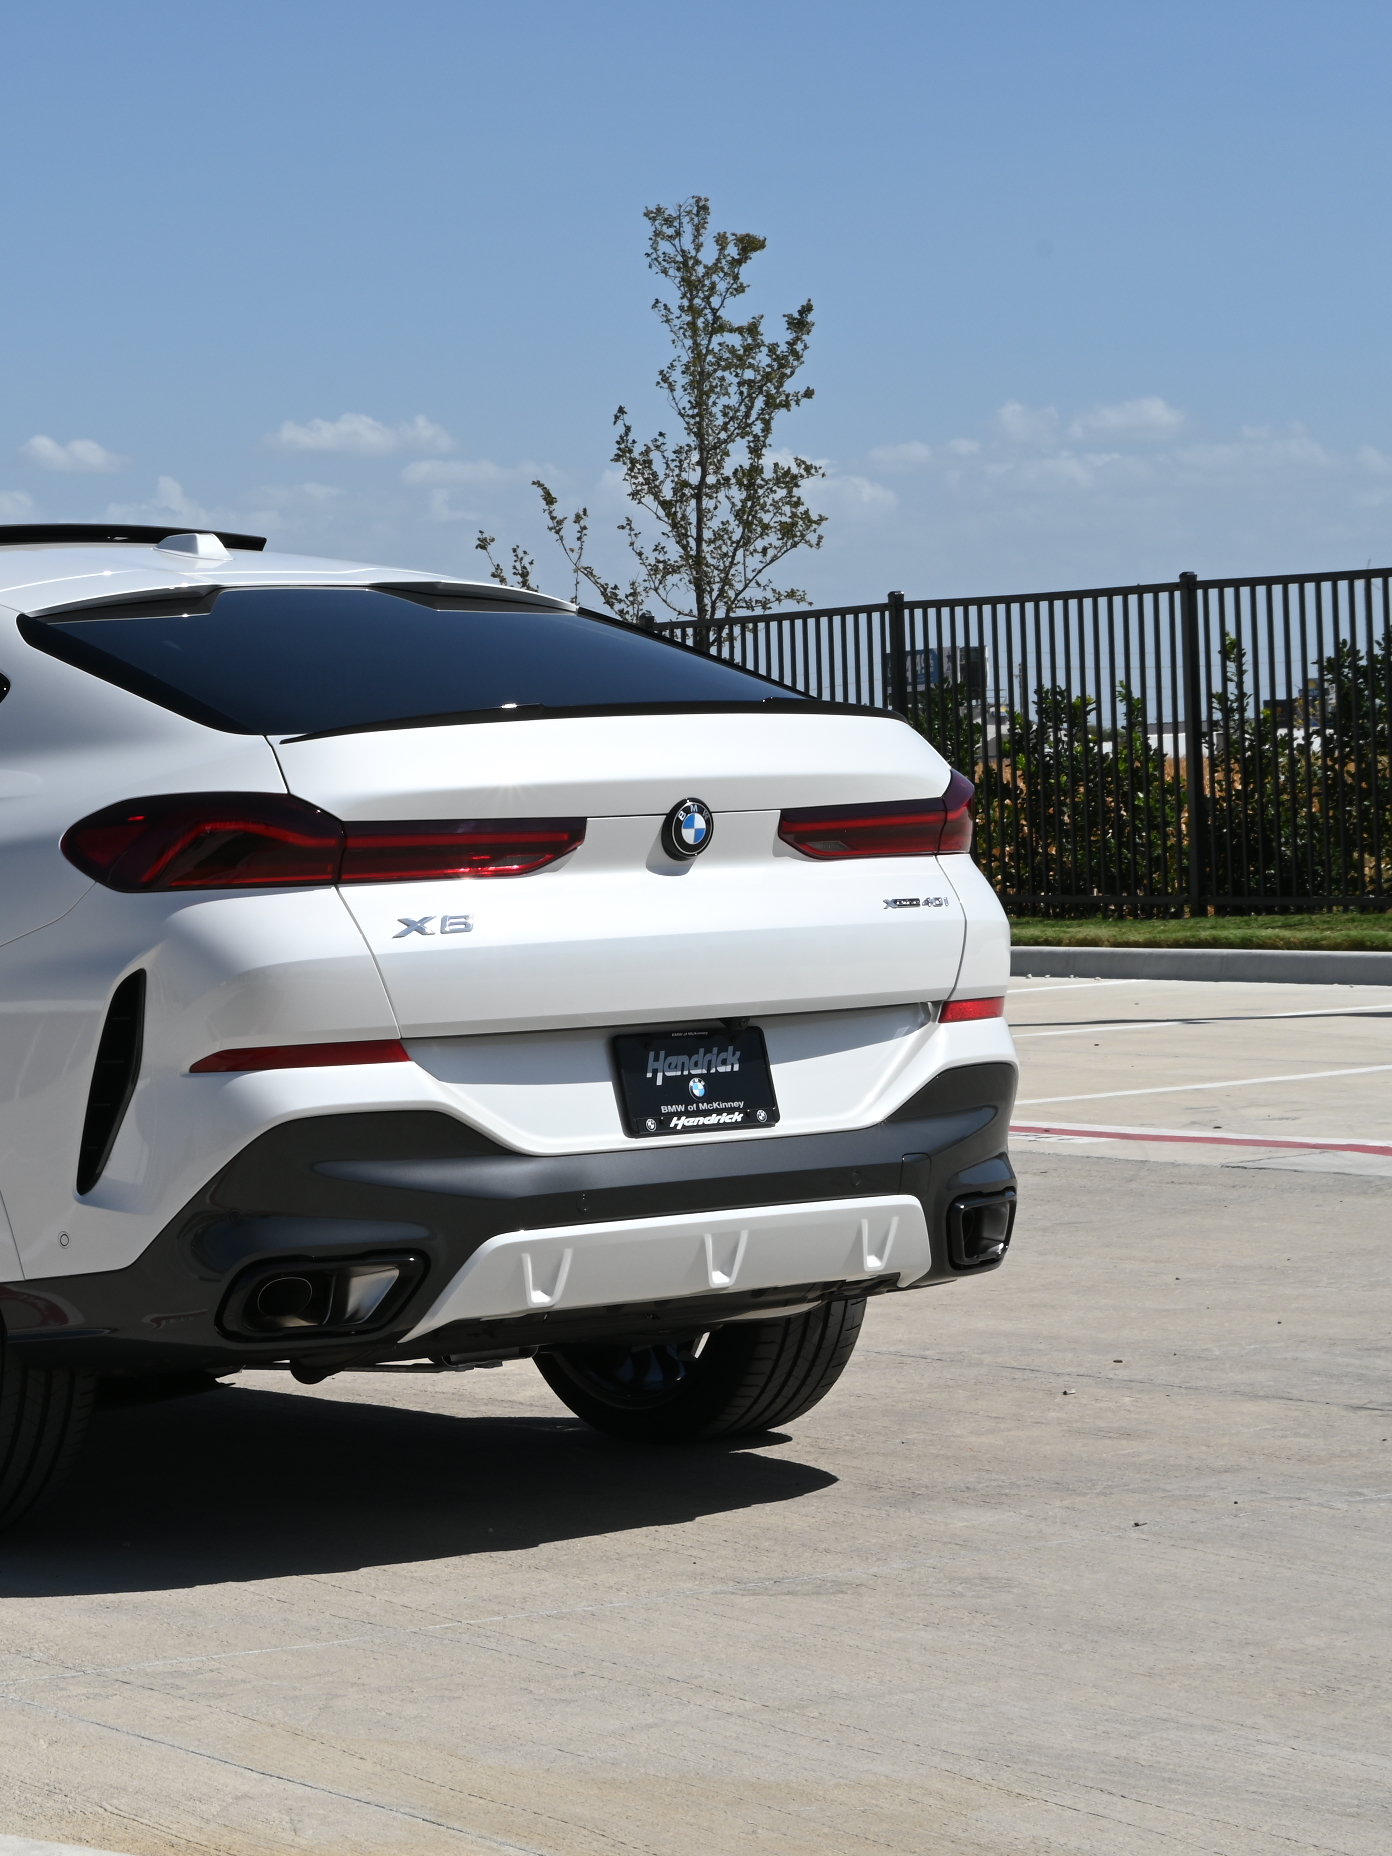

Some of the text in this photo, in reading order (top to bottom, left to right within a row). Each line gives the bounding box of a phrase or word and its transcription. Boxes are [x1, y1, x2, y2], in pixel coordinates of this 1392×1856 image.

[677, 804, 709, 821] BMW
[392, 914, 474, 939] X6
[646, 1046, 741, 1086] Hendrick
[661, 1100, 745, 1114] BMW of McKinney
[669, 1111, 744, 1130] Hendrick
